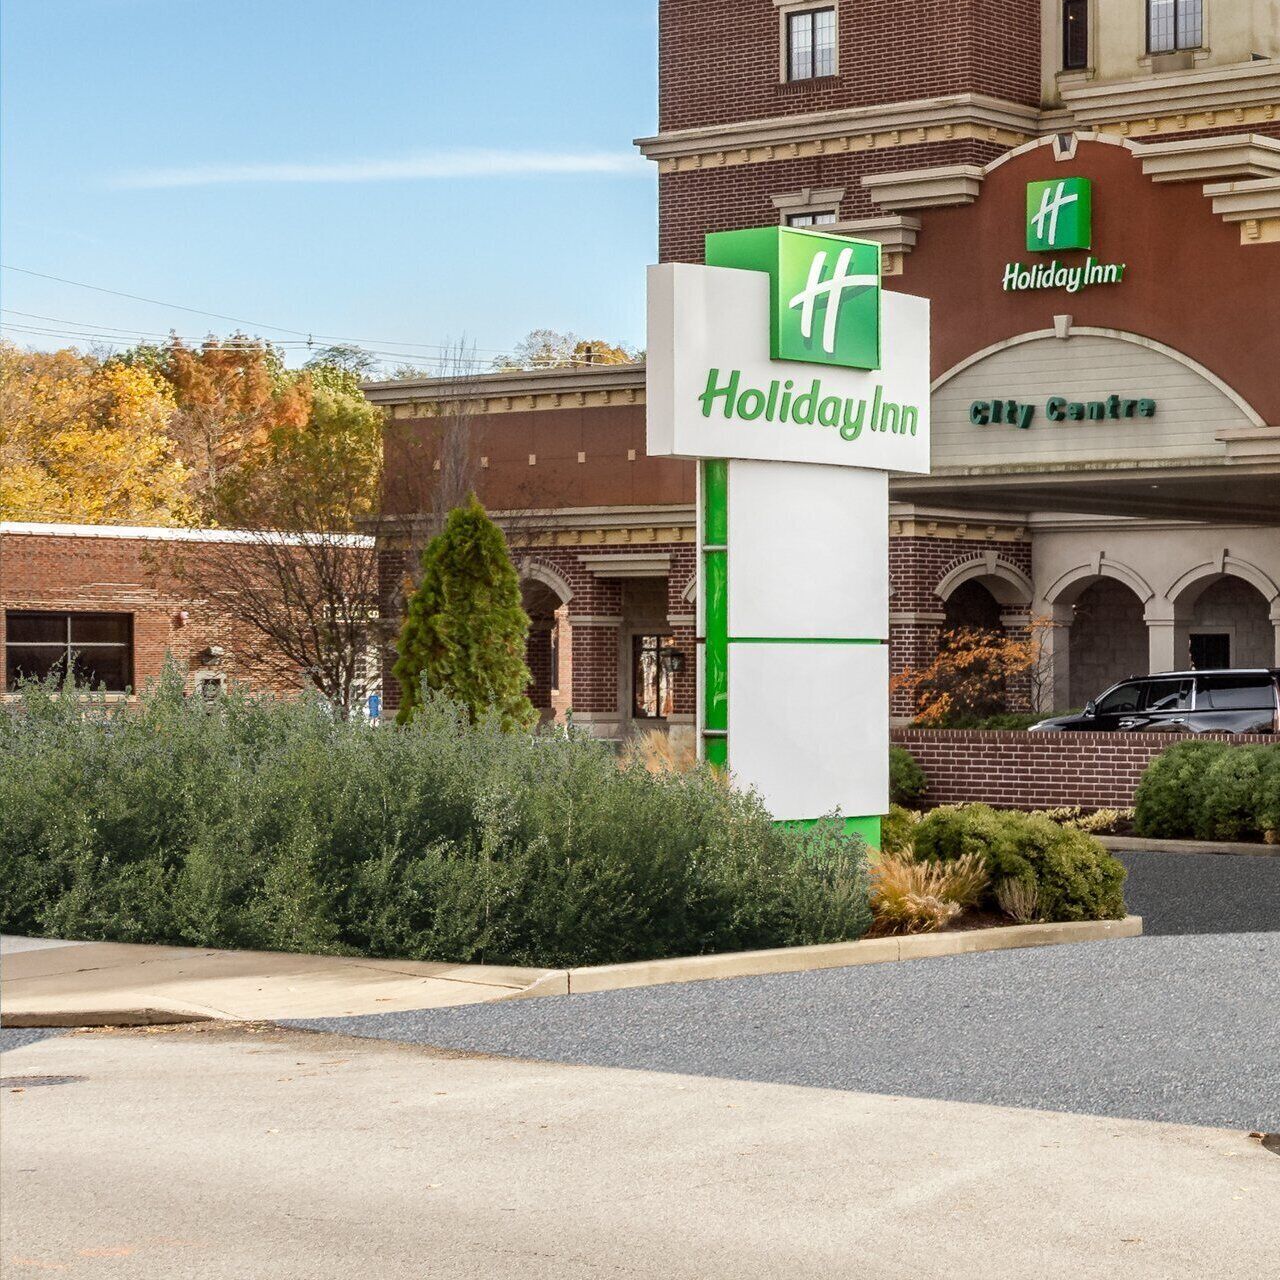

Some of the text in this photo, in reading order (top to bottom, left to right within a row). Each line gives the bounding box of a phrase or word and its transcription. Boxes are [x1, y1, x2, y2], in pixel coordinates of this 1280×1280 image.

[1002, 257, 1118, 292] Holiday Inn
[698, 368, 919, 441] Holiday Inn
[970, 394, 1157, 429] City Centre
